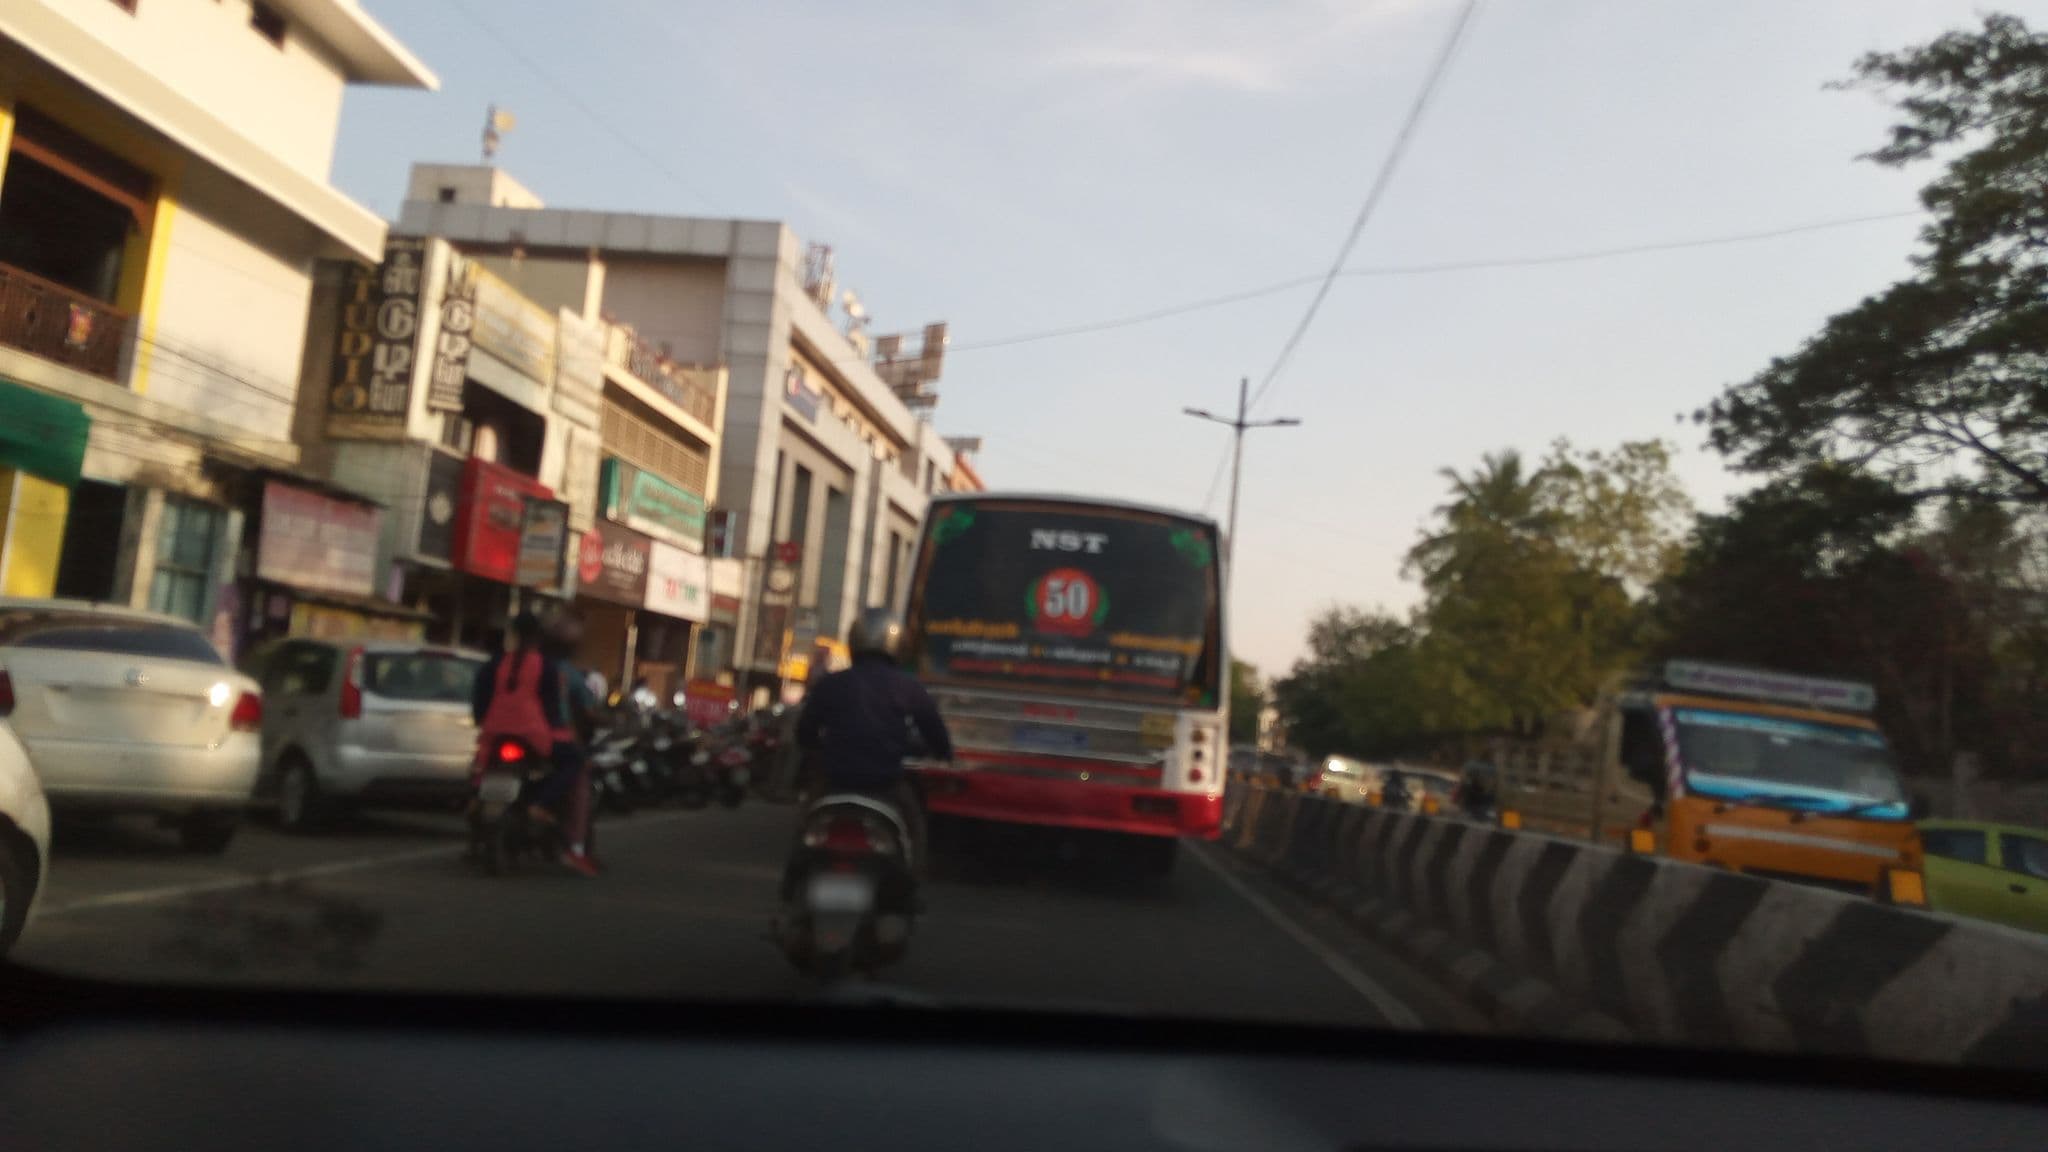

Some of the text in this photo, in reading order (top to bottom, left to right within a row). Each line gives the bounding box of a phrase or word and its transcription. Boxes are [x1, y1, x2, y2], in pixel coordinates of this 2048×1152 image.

[332, 264, 378, 410] TUDIO
[1030, 528, 1109, 553] NST
[1044, 578, 1090, 620] 50
